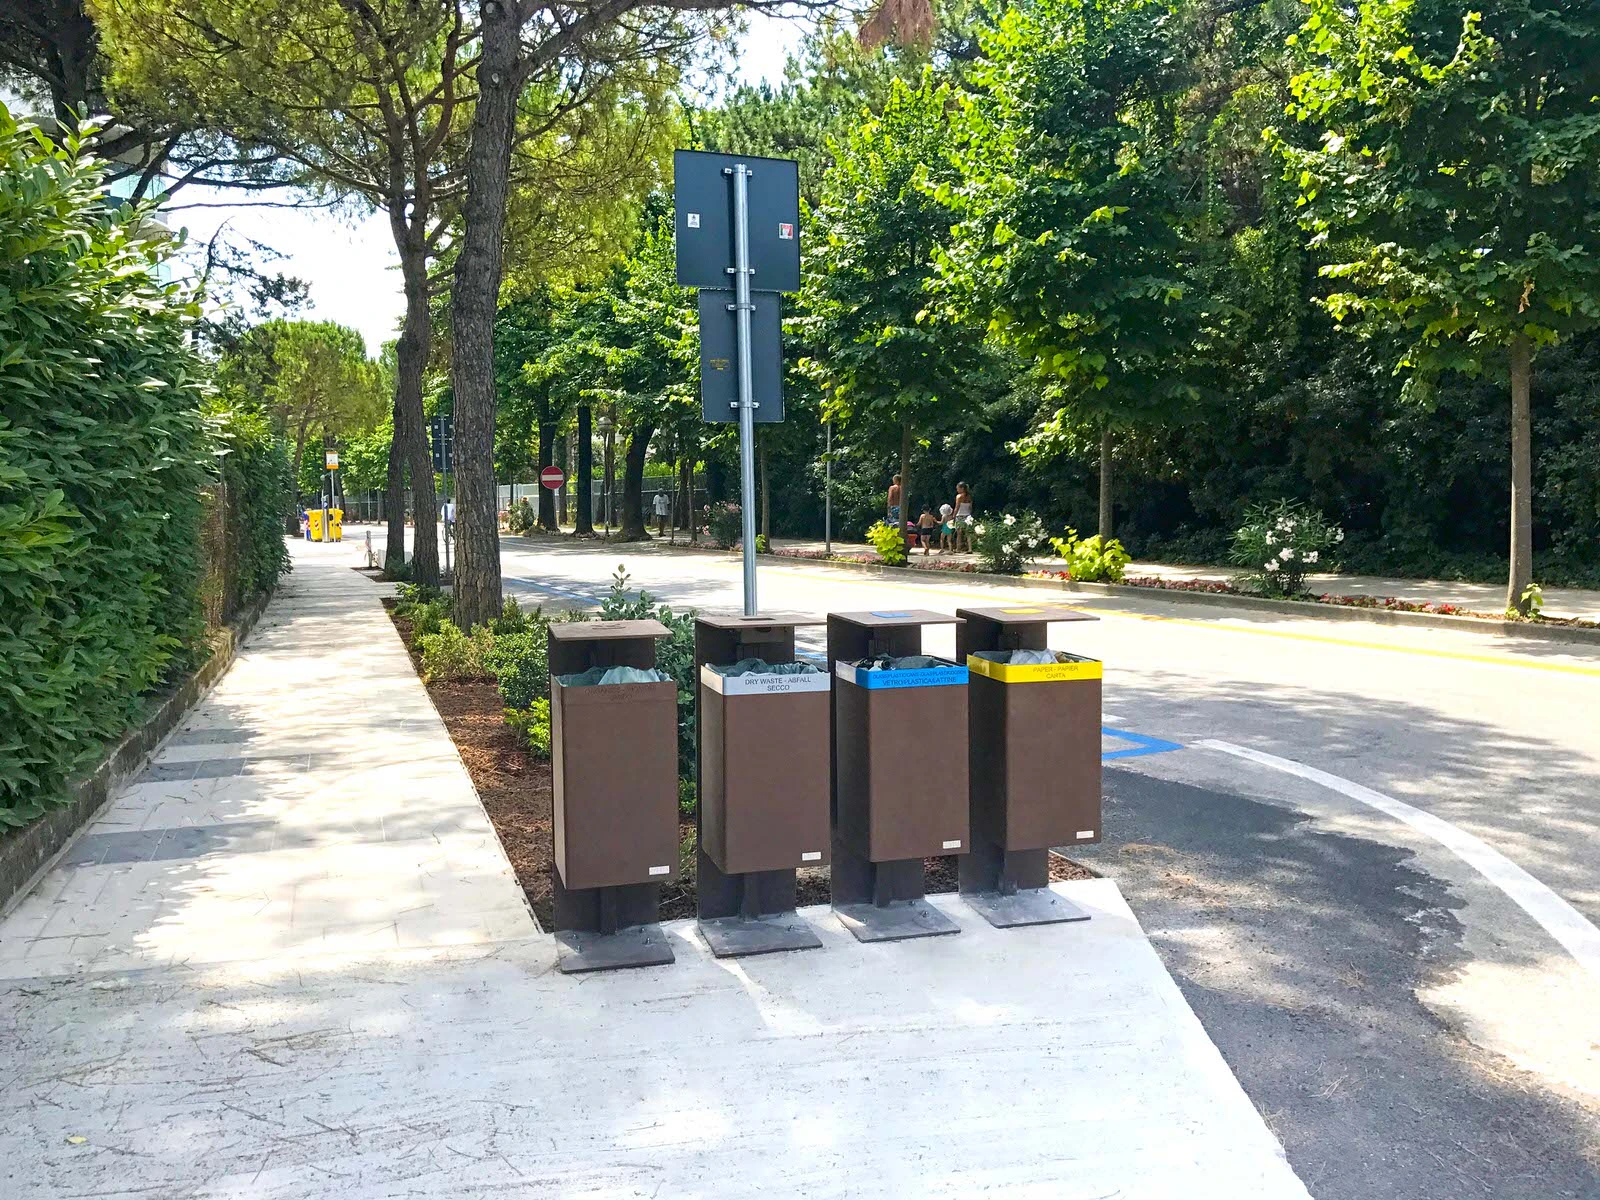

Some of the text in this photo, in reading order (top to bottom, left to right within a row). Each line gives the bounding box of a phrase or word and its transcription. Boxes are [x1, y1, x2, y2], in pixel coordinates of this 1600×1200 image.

[745, 678, 758, 686] DRY
[760, 677, 783, 685] WASTE
[788, 676, 811, 684] ABFALL
